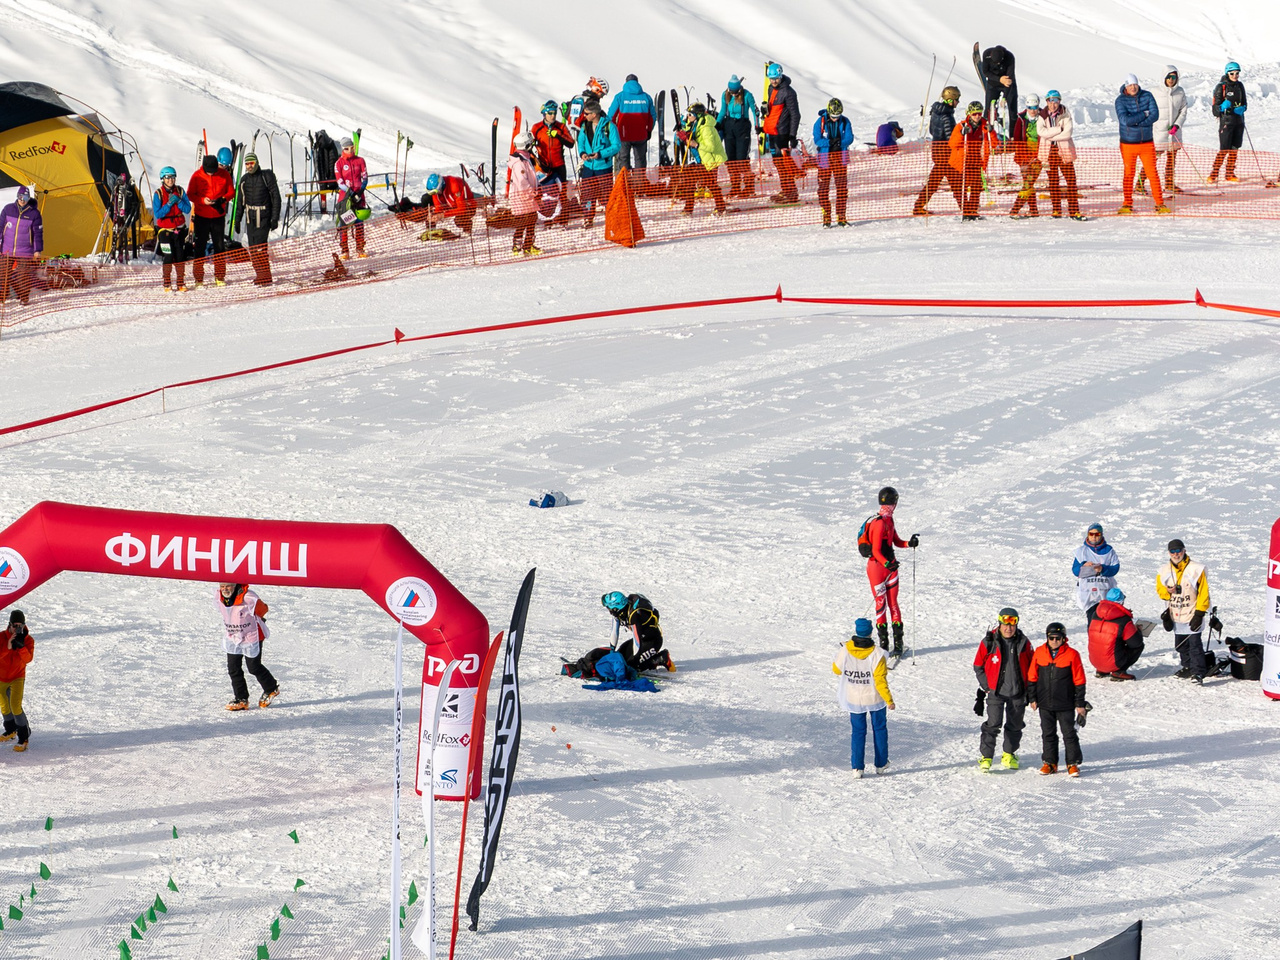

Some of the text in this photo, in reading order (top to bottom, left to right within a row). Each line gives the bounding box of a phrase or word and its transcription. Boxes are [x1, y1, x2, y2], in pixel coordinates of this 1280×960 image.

[9, 144, 52, 161] RedFox
[104, 532, 308, 578] ФИНИШ
[844, 670, 871, 679] СУДЬЯ
